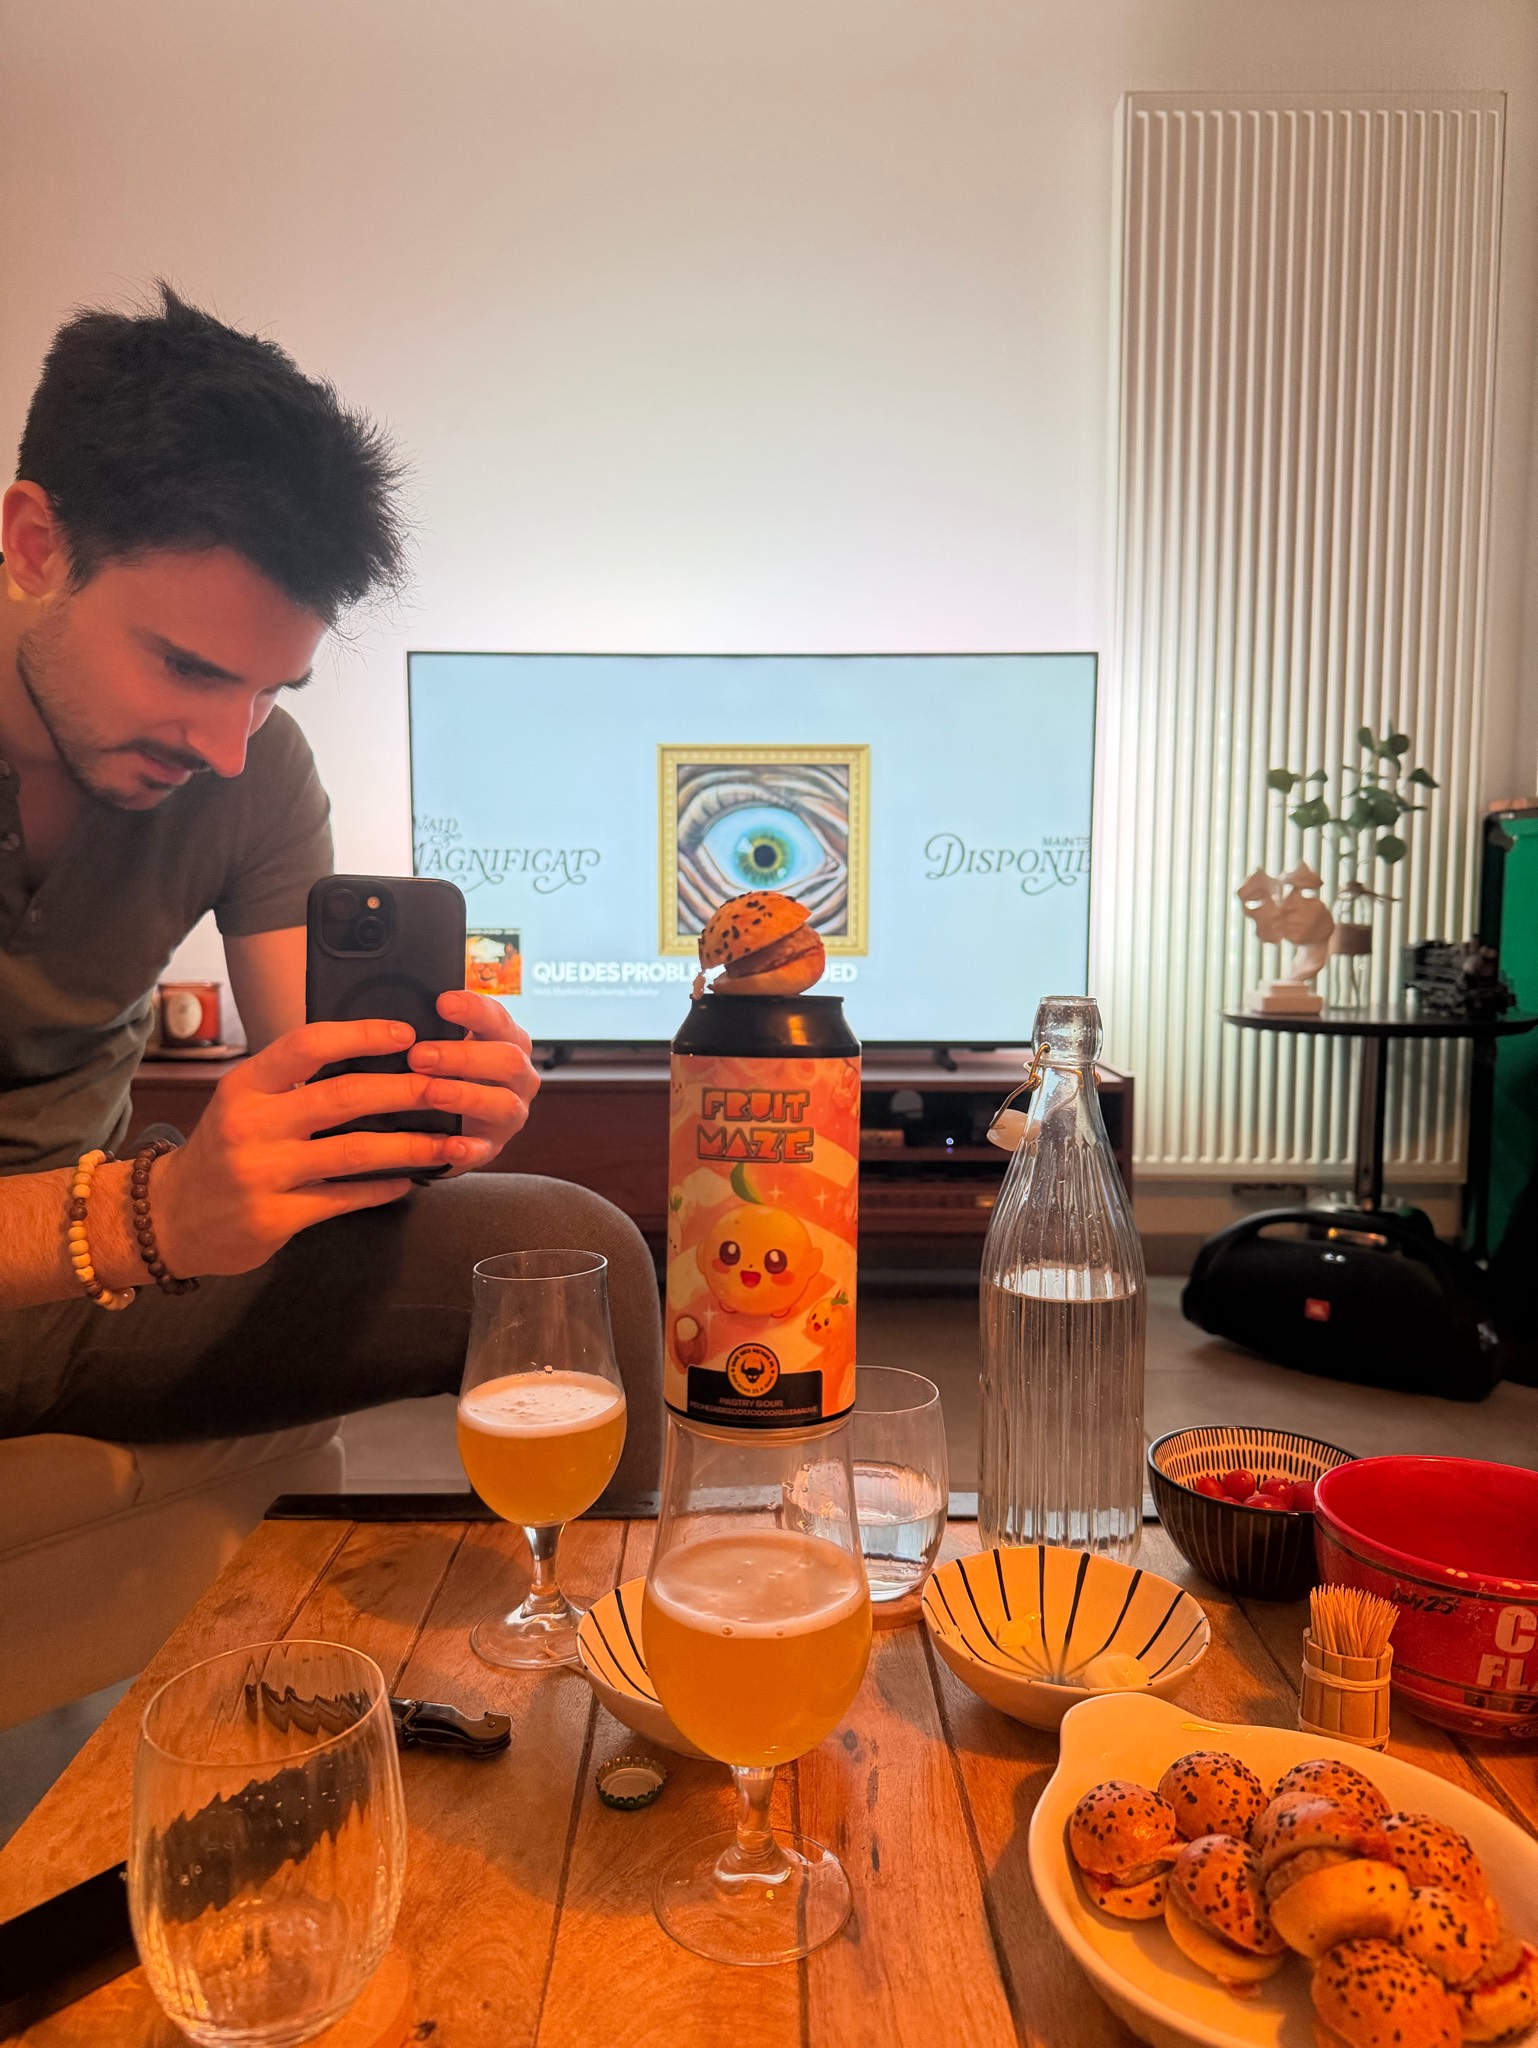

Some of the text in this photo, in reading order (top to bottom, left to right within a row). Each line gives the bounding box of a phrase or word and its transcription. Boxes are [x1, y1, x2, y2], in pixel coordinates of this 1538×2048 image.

[532, 961, 579, 984] QUE
[579, 961, 622, 983] DES
[702, 1087, 810, 1122] FRUIT
[697, 1123, 814, 1163] MAZE
[719, 1397, 785, 1408] PASTRY SOUR
[1476, 1653, 1538, 1693] FL
